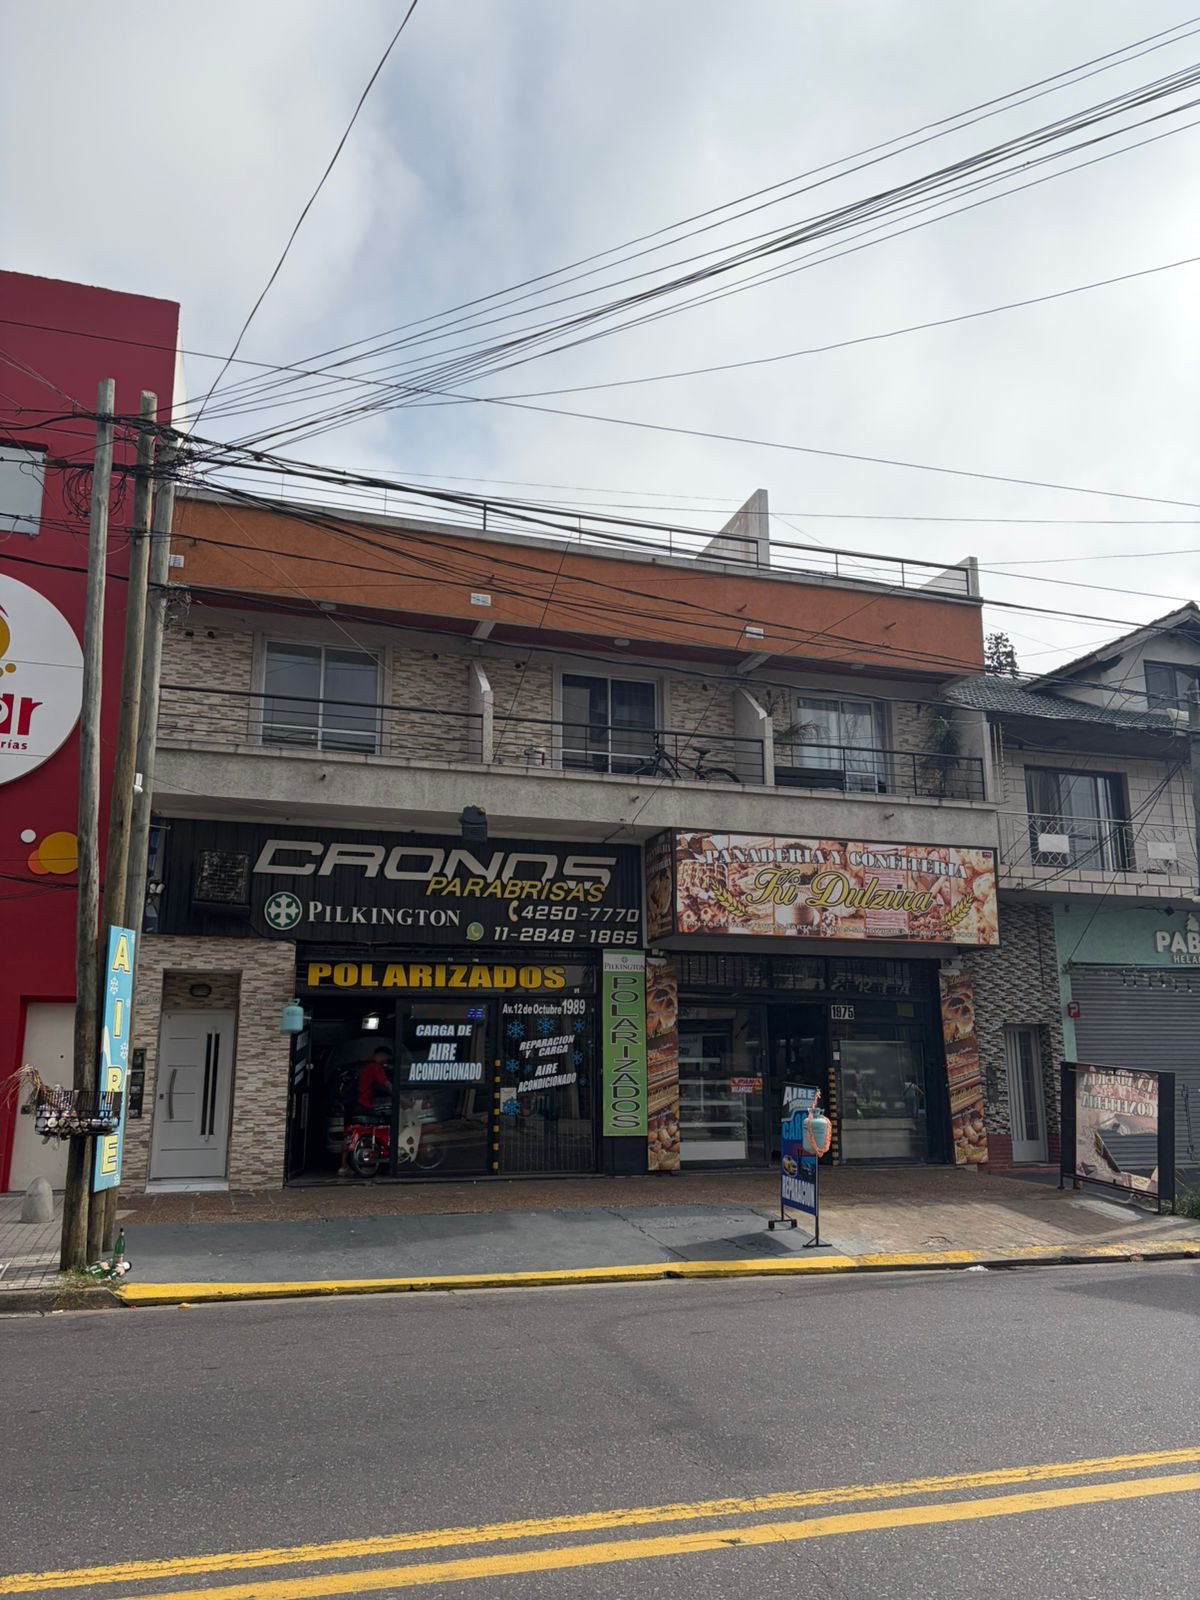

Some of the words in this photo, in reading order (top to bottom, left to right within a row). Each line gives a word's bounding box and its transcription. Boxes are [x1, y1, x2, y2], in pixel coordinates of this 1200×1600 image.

[252, 839, 617, 889] CRONOS
[705, 849, 826, 865] PANADERIA
[828, 852, 842, 866] Y
[850, 852, 968, 879] CONFITERIA
[425, 876, 606, 902] PARABRISAS
[745, 867, 799, 907] Ki
[805, 871, 933, 913] Dulzura
[307, 901, 461, 927] PILKINGTON
[1173, 954, 1200, 964] HELA
[307, 962, 567, 990] POLARIZADOS
[533, 1003, 562, 1015] Octubre
[562, 999, 586, 1015] 1989
[832, 1006, 854, 1019] 1975
[416, 1025, 455, 1037] CARGA
[456, 1025, 472, 1037] DE
[428, 1043, 457, 1061] AIRE
[519, 1034, 575, 1051] REPARACION
[524, 1050, 531, 1058] Y
[538, 1045, 569, 1056] CARGA
[610, 976, 641, 1129] POLARIZADOS
[101, 934, 131, 1176] AIRE
[408, 1063, 482, 1081] ACONDICIONADO
[535, 1063, 559, 1077] AIRE
[518, 1073, 577, 1093] ACONDICIONADO
[783, 1086, 815, 1106] AIRE
